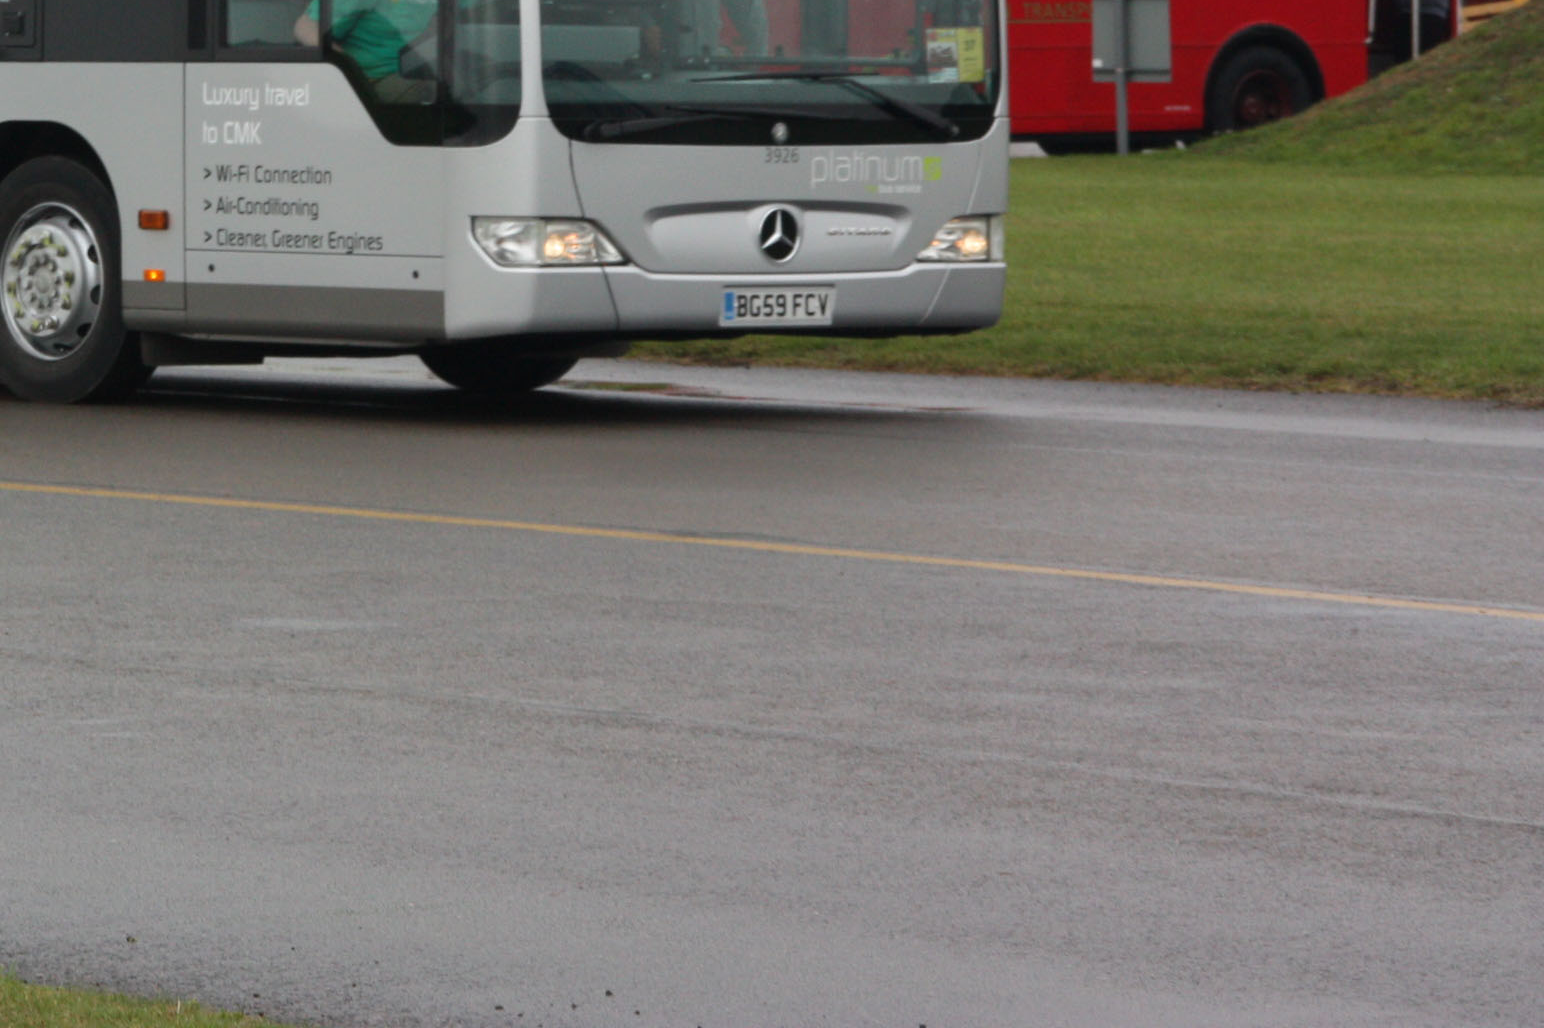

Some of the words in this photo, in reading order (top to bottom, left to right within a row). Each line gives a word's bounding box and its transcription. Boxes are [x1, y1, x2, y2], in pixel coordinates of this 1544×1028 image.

[202, 82, 260, 111] Luxury
[264, 83, 309, 106] travel
[202, 122, 217, 144] to
[223, 122, 262, 145] CMK
[765, 147, 800, 164] 3926
[216, 165, 251, 183] Wi-Fi
[254, 165, 332, 185] Connection
[810, 150, 923, 190] platinum
[216, 196, 320, 221] Air-Conditioning
[271, 229, 324, 249] Greener
[328, 231, 384, 255] Engines
[736, 293, 787, 318] BG59
[792, 292, 829, 317] FCV
